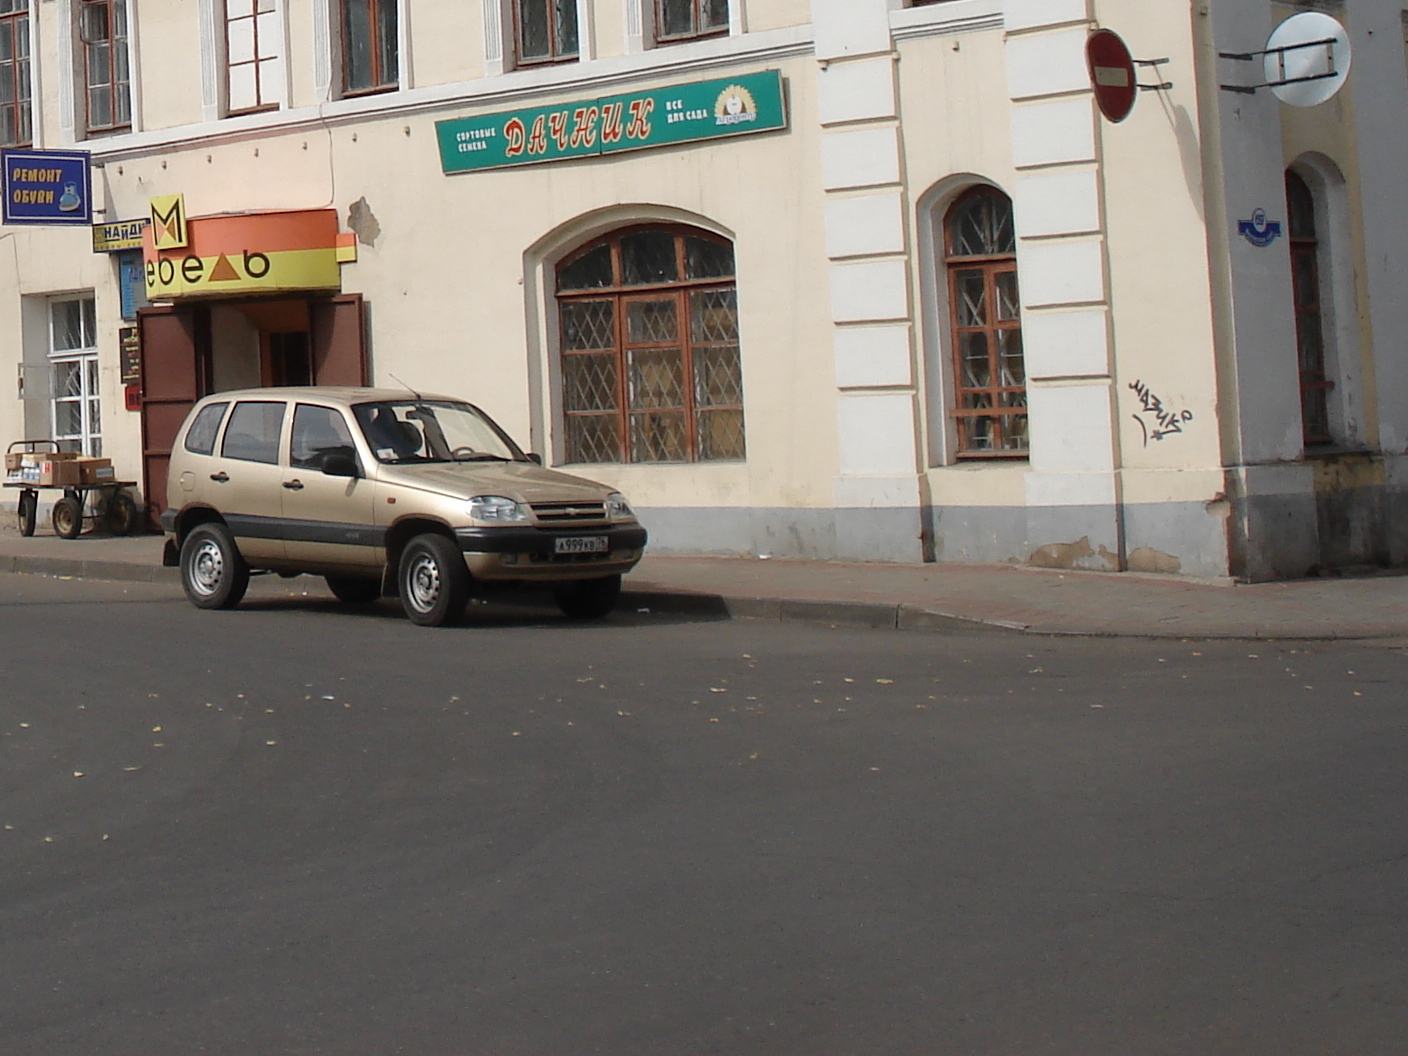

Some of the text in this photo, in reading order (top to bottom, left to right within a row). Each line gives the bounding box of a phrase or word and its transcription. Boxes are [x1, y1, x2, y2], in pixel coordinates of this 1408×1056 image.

[456, 127, 496, 142] СОРТОВЫЕ
[503, 97, 655, 158] ДАЧНИК
[458, 140, 487, 153] СЕМЕНА
[12, 167, 62, 183] РЕМОНТ
[13, 190, 54, 204] ОБУВИ
